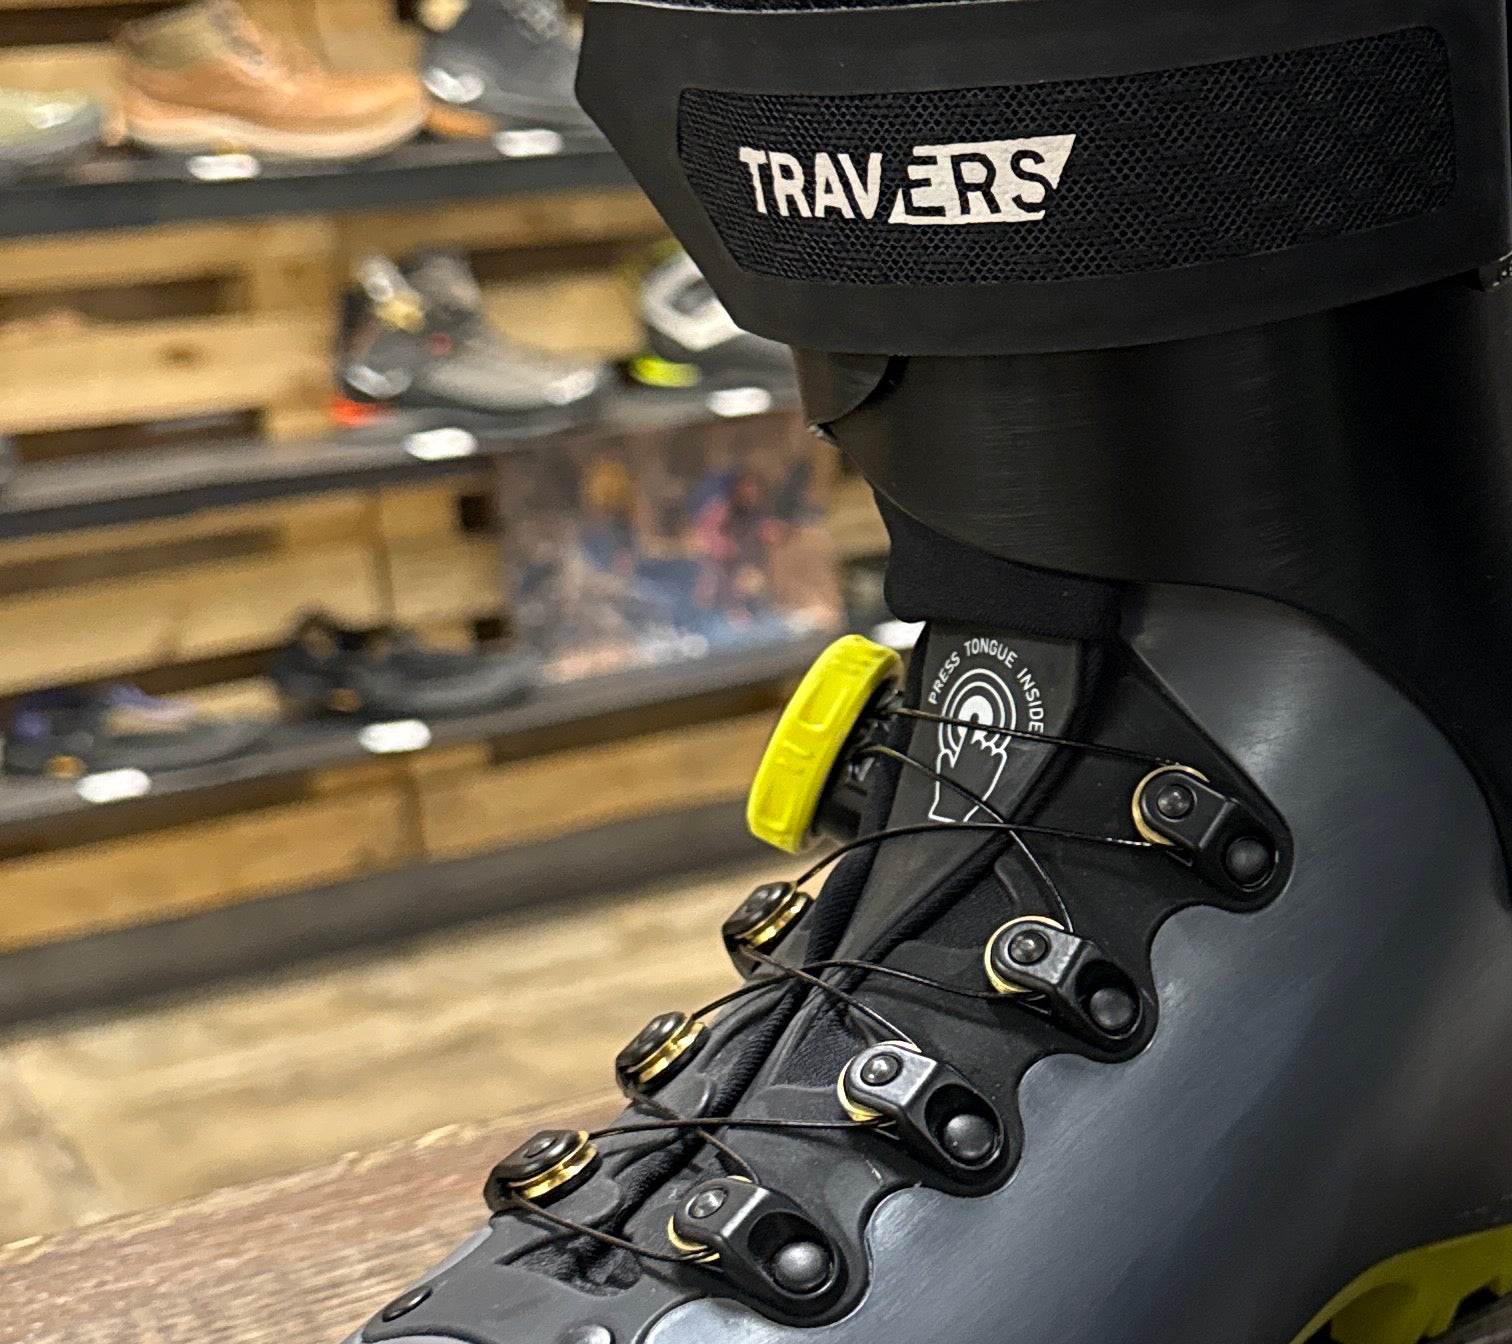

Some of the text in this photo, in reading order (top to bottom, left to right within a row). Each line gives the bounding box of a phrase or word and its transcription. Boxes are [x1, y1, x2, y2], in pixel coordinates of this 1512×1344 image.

[739, 134, 1077, 226] TRAVERS
[928, 637, 1045, 733] PRESS TONGUE INSIDE
